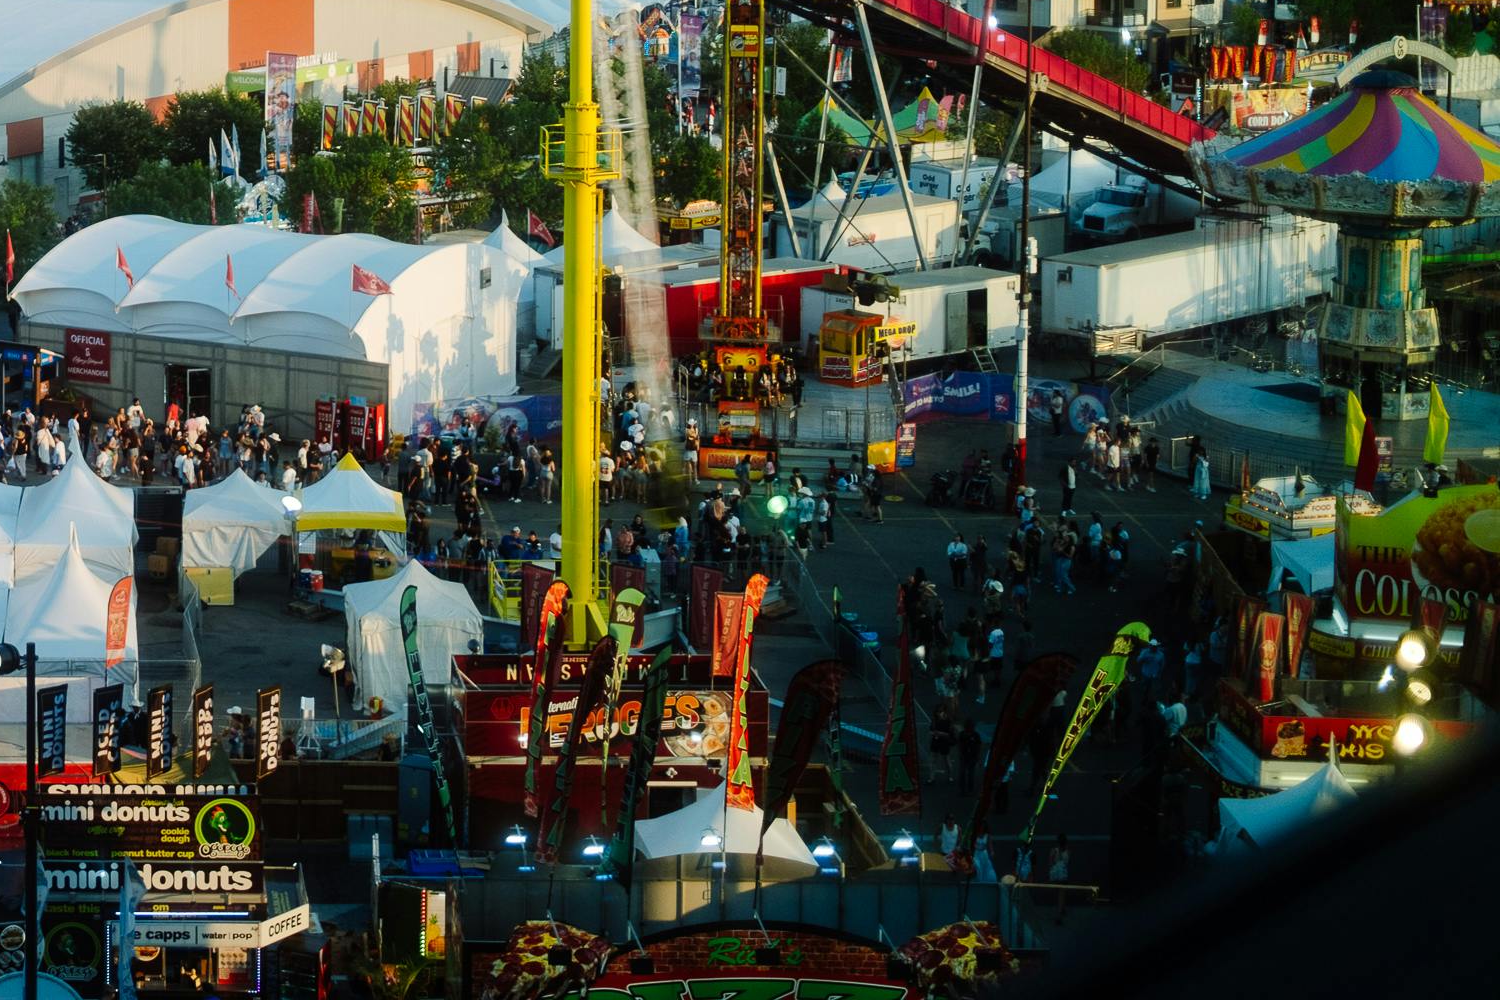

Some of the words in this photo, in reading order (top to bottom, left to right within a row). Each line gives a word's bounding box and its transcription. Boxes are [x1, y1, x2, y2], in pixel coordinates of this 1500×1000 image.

[70, 334, 106, 346] OFFICIAL
[879, 328, 897, 339] MEGA
[898, 324, 916, 335] DROP
[67, 366, 109, 377] MERCHANDISE
[943, 382, 981, 398] SMILE!
[1358, 544, 1404, 562] THE
[42, 709, 53, 760] MINI
[52, 692, 65, 770] DONUTS
[97, 708, 110, 757] ICED
[151, 709, 163, 760] MINI
[261, 710, 271, 760] MINI
[267, 693, 280, 770] DONUTS
[41, 800, 94, 821] mini
[101, 801, 191, 822] donuts
[160, 827, 191, 836] cookie
[160, 834, 191, 844] dough
[110, 850, 144, 861] peanut
[146, 849, 174, 859] butter
[176, 851, 196, 860] cup
[46, 861, 121, 890] mini
[268, 912, 302, 938] COFFEE
[146, 929, 191, 942] capps
[201, 931, 227, 940] water
[232, 931, 253, 941] pop
